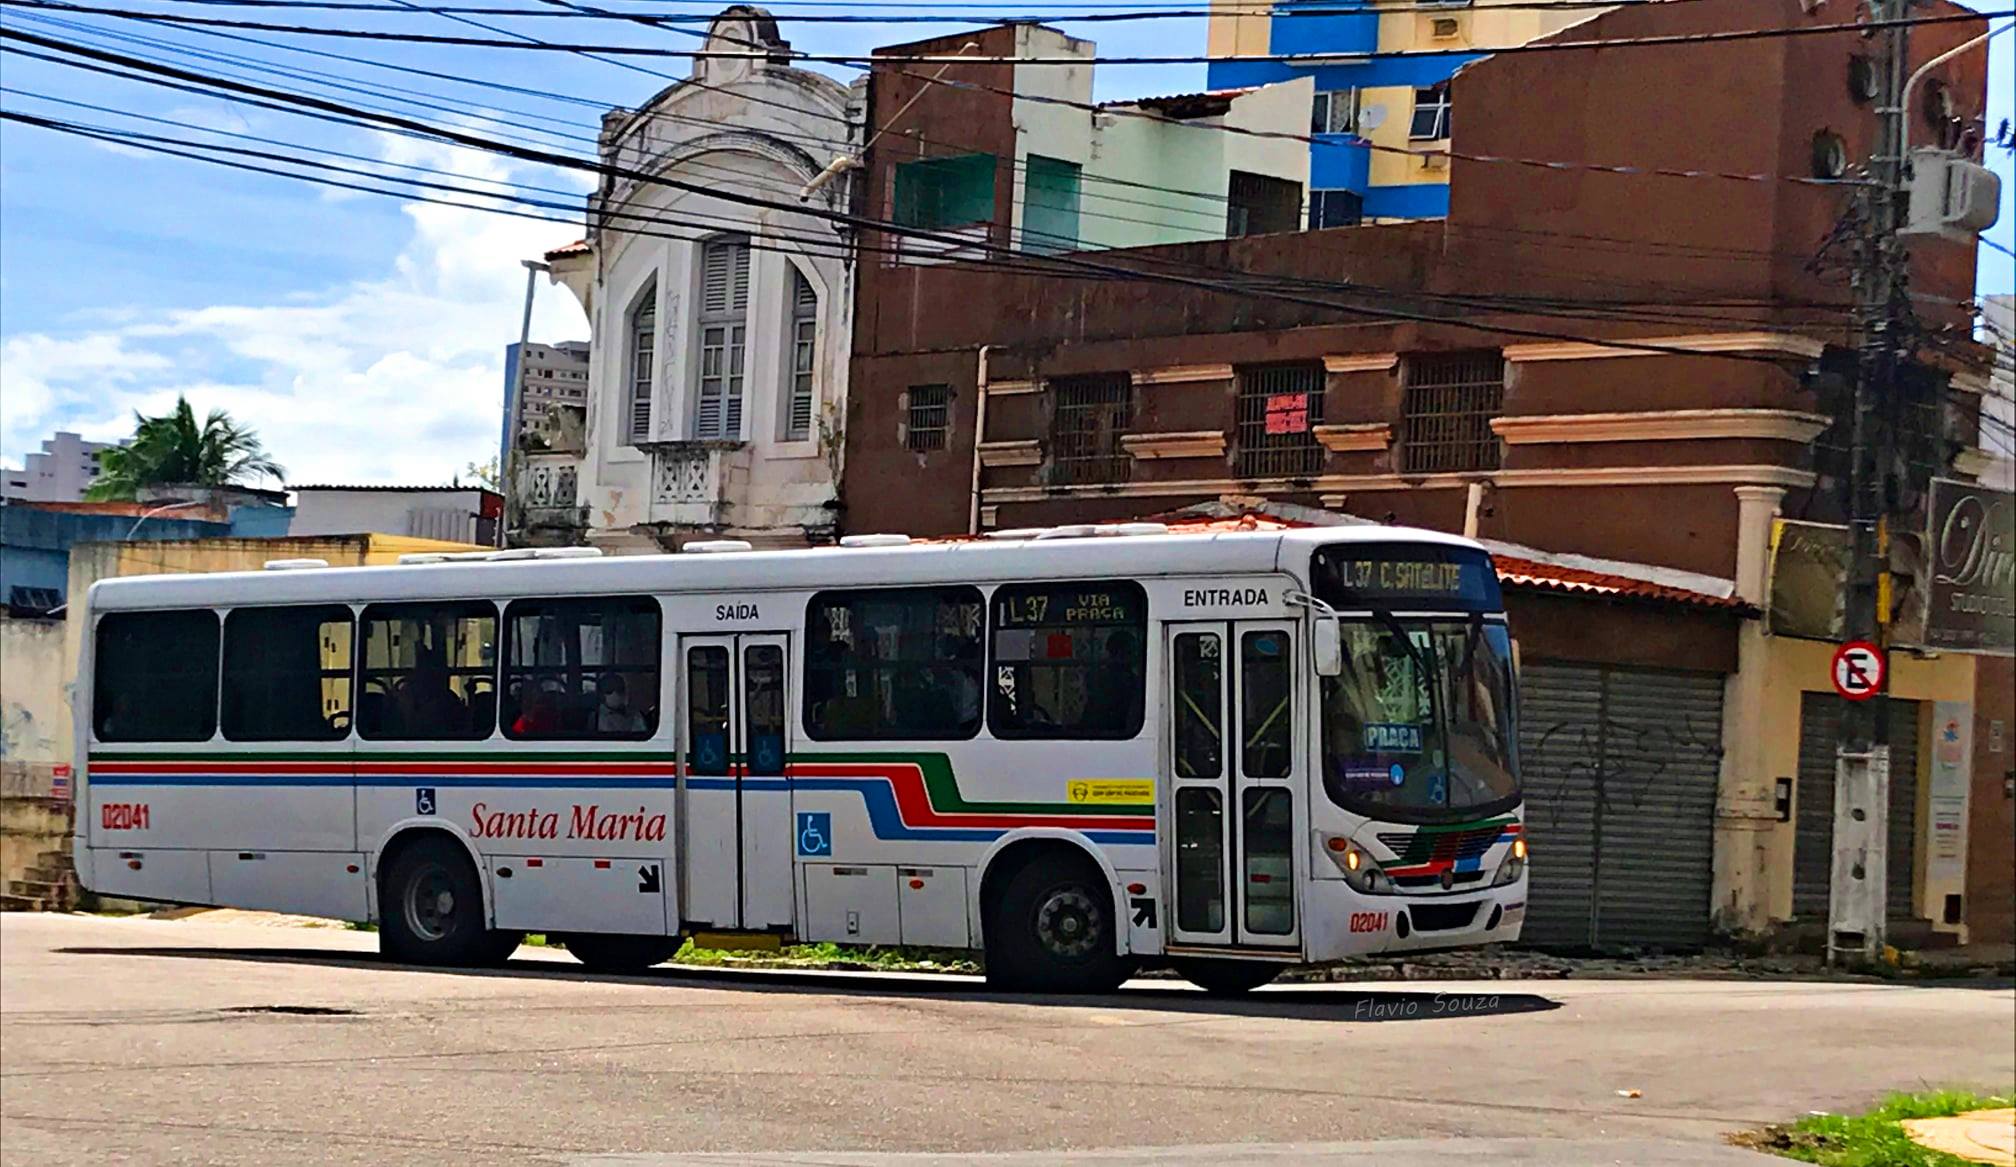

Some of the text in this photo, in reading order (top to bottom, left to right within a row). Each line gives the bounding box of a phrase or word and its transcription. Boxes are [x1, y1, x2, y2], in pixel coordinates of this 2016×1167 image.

[1078, 593, 1110, 606] VIA
[1184, 588, 1268, 607] ENTRADA
[716, 600, 759, 621] SAÍDA
[1846, 653, 1868, 690] E
[102, 803, 149, 830] 02041
[469, 803, 667, 842] Santa Maria
[1350, 912, 1389, 933] 02041
